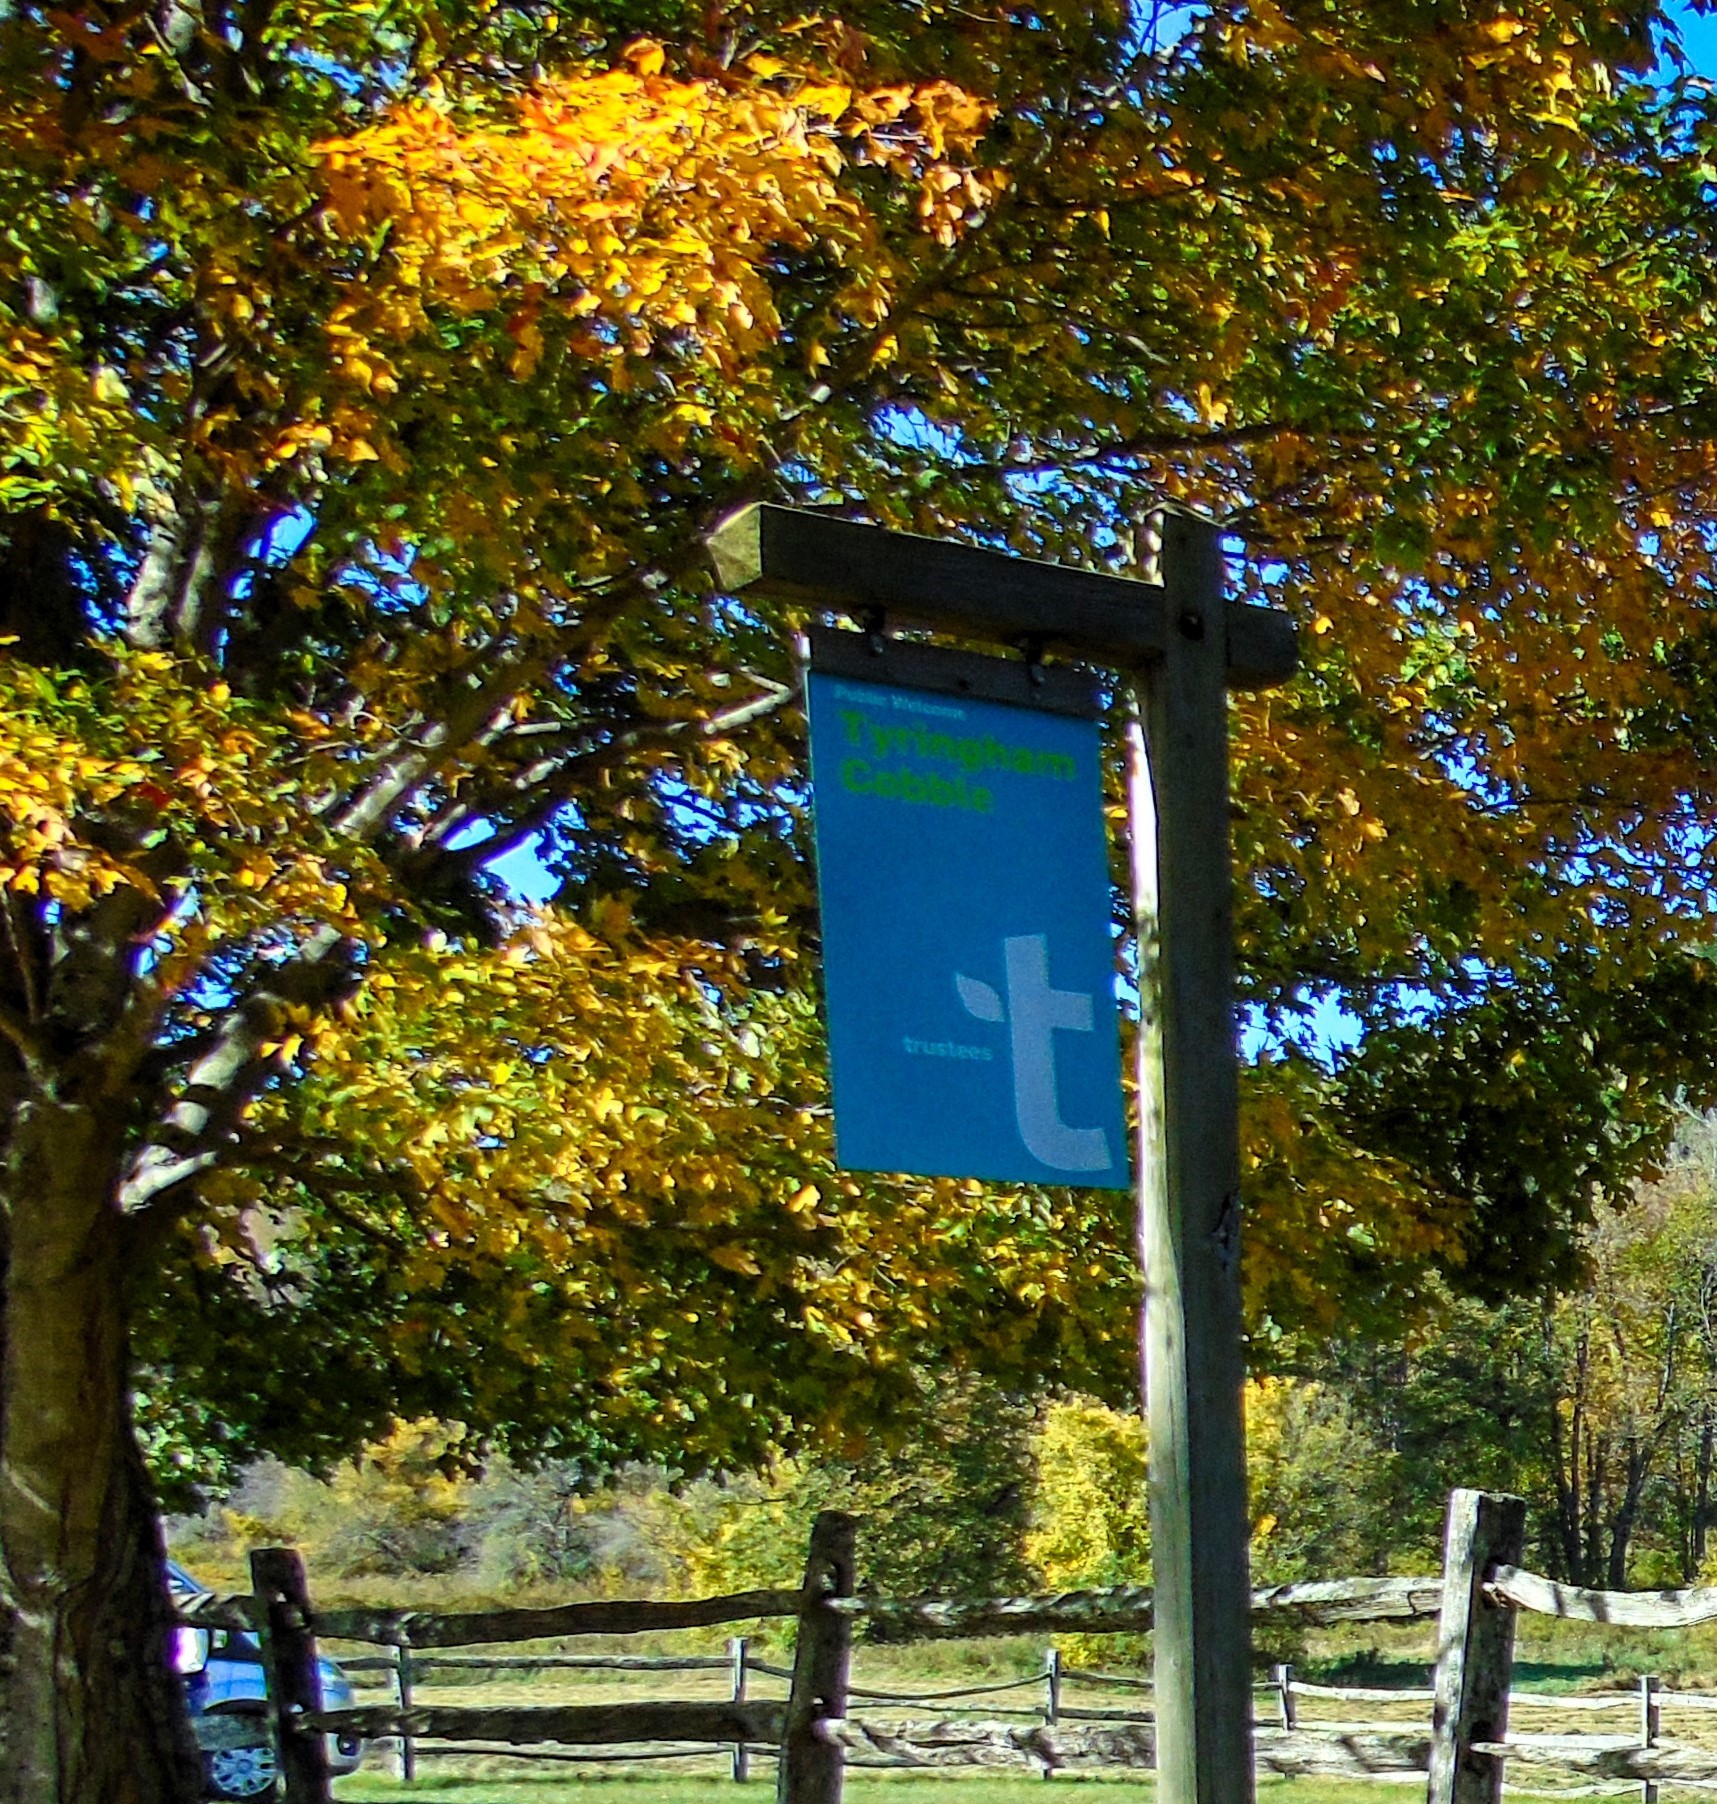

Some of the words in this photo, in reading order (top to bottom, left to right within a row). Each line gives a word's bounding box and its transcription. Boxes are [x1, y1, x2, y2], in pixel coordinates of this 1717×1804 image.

[838, 709, 1077, 782] Tyringham
[841, 758, 994, 814] Cobble
[903, 1036, 993, 1061] trustees
